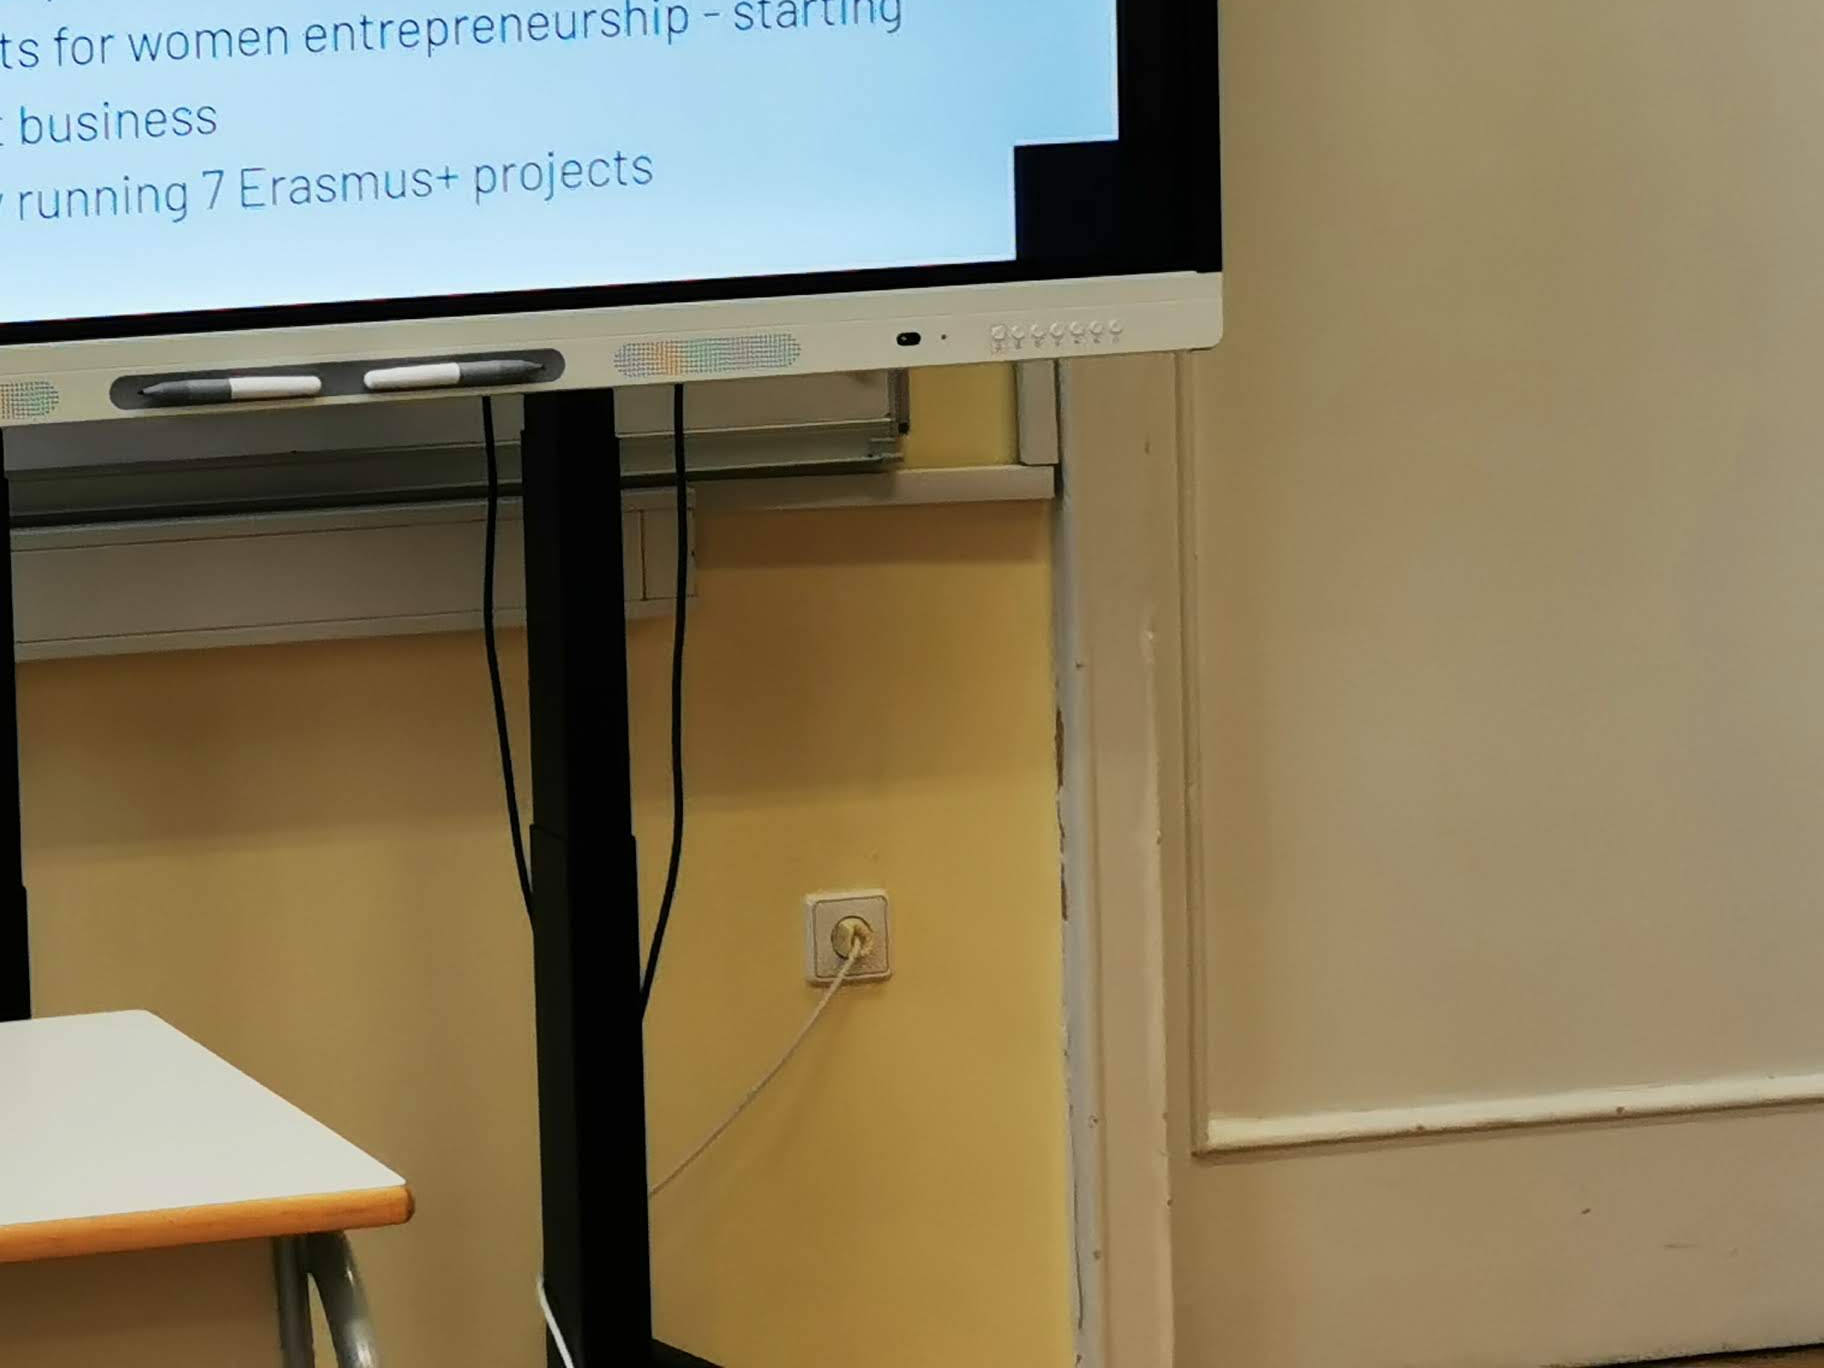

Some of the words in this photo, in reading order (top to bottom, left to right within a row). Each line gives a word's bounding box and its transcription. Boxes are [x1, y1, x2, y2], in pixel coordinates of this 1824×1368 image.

[54, 26, 115, 68] for
[129, 19, 290, 62] women
[20, 102, 219, 147] business
[19, 175, 190, 223] running
[202, 170, 225, 212] 7
[240, 166, 460, 210] Erasmus+
[474, 150, 654, 205] projects
